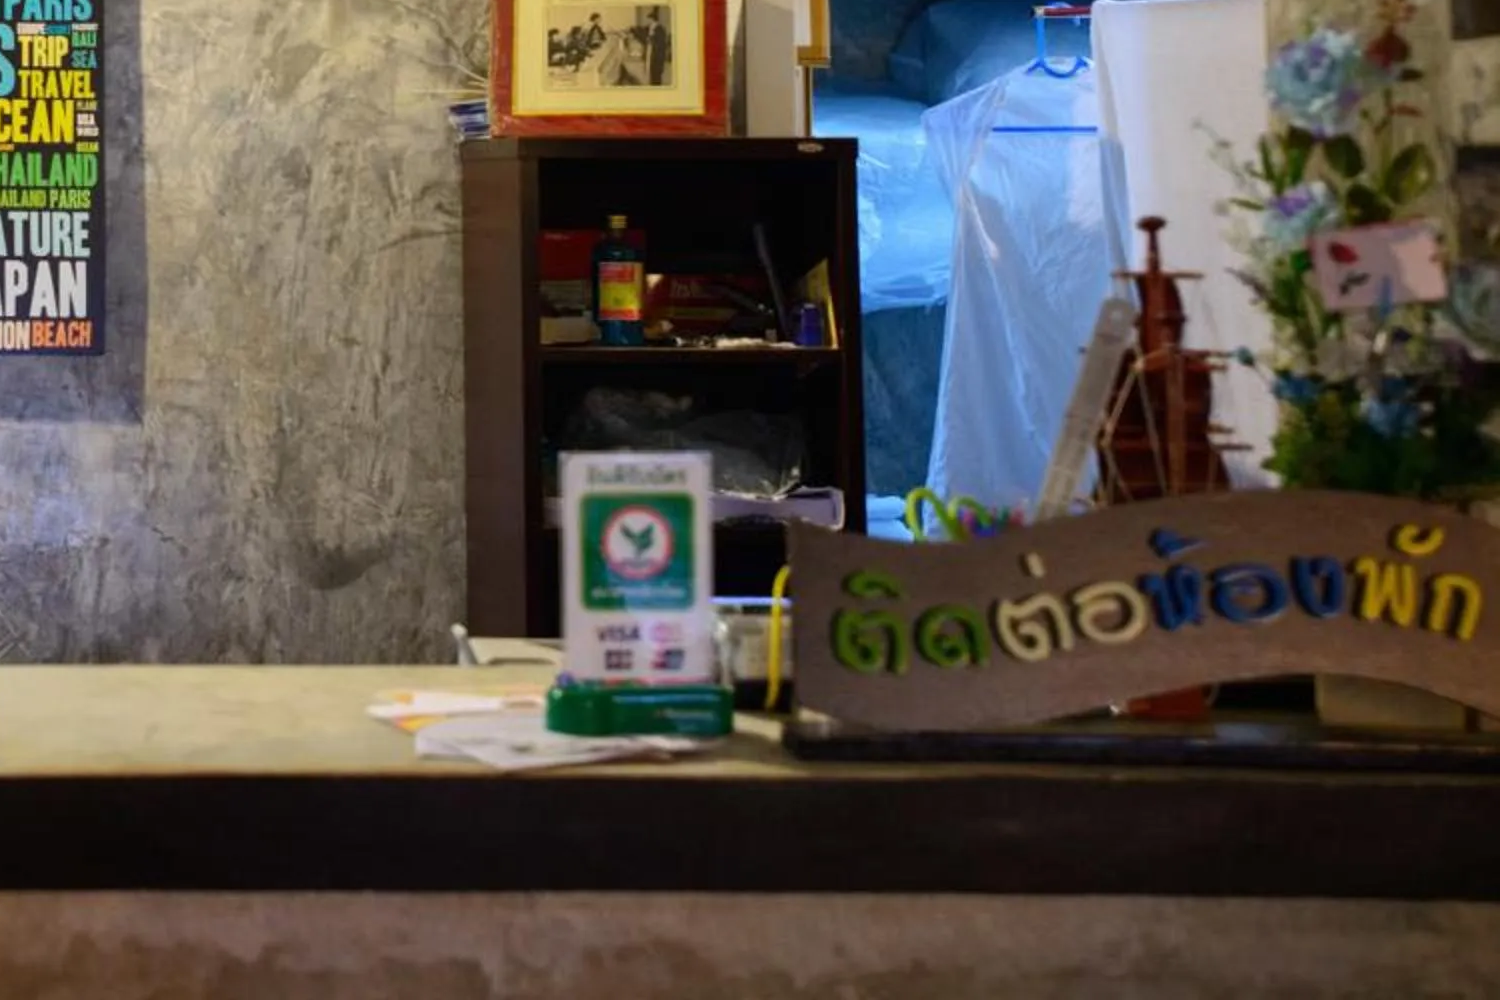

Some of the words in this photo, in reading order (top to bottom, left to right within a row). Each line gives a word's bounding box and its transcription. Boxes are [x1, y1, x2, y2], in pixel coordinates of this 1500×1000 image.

[17, 34, 69, 68] TRIP
[70, 49, 98, 69] SEA
[18, 69, 96, 99] TRAVEL
[49, 187, 92, 209] PARIS
[31, 320, 92, 348] BEACH
[829, 523, 1484, 677] ติดต่อห้องพัก
